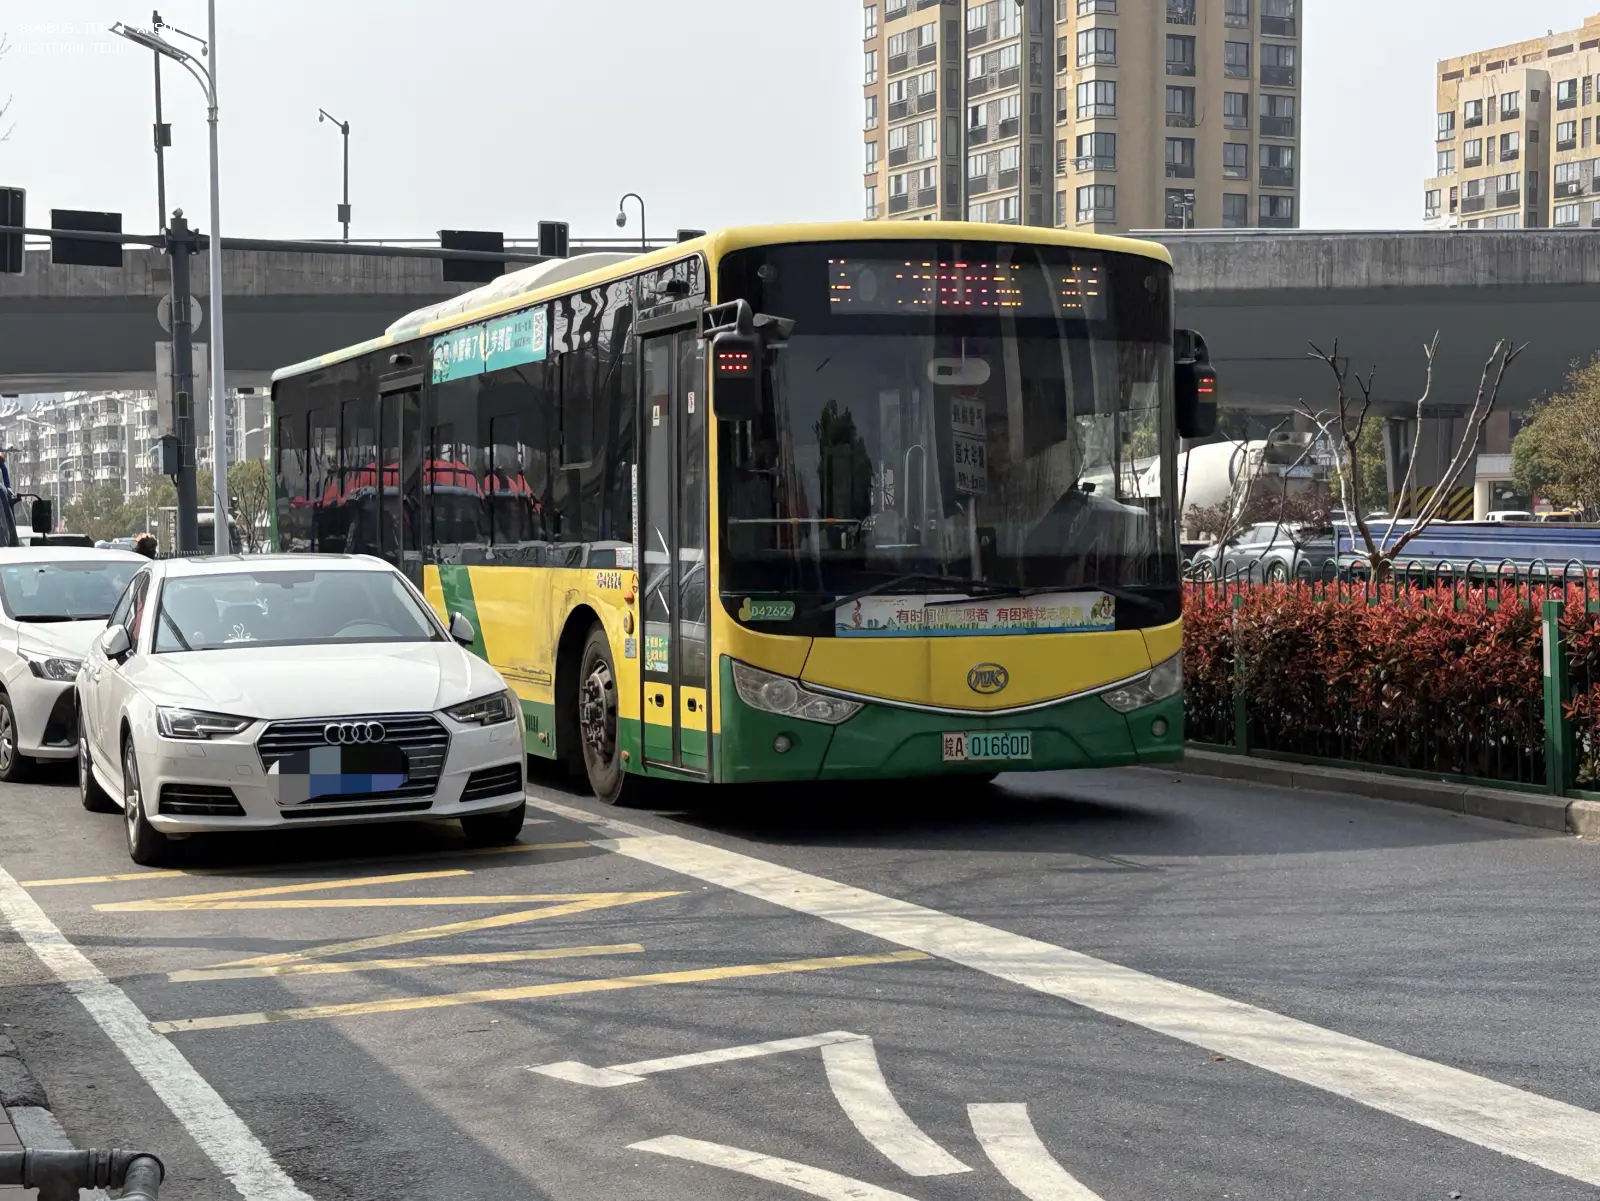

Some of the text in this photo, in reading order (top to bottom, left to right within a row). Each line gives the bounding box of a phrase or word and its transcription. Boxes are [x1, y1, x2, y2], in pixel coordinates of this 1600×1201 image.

[751, 606, 794, 617] D42624
[896, 607, 989, 623] 有时间做志愿者
